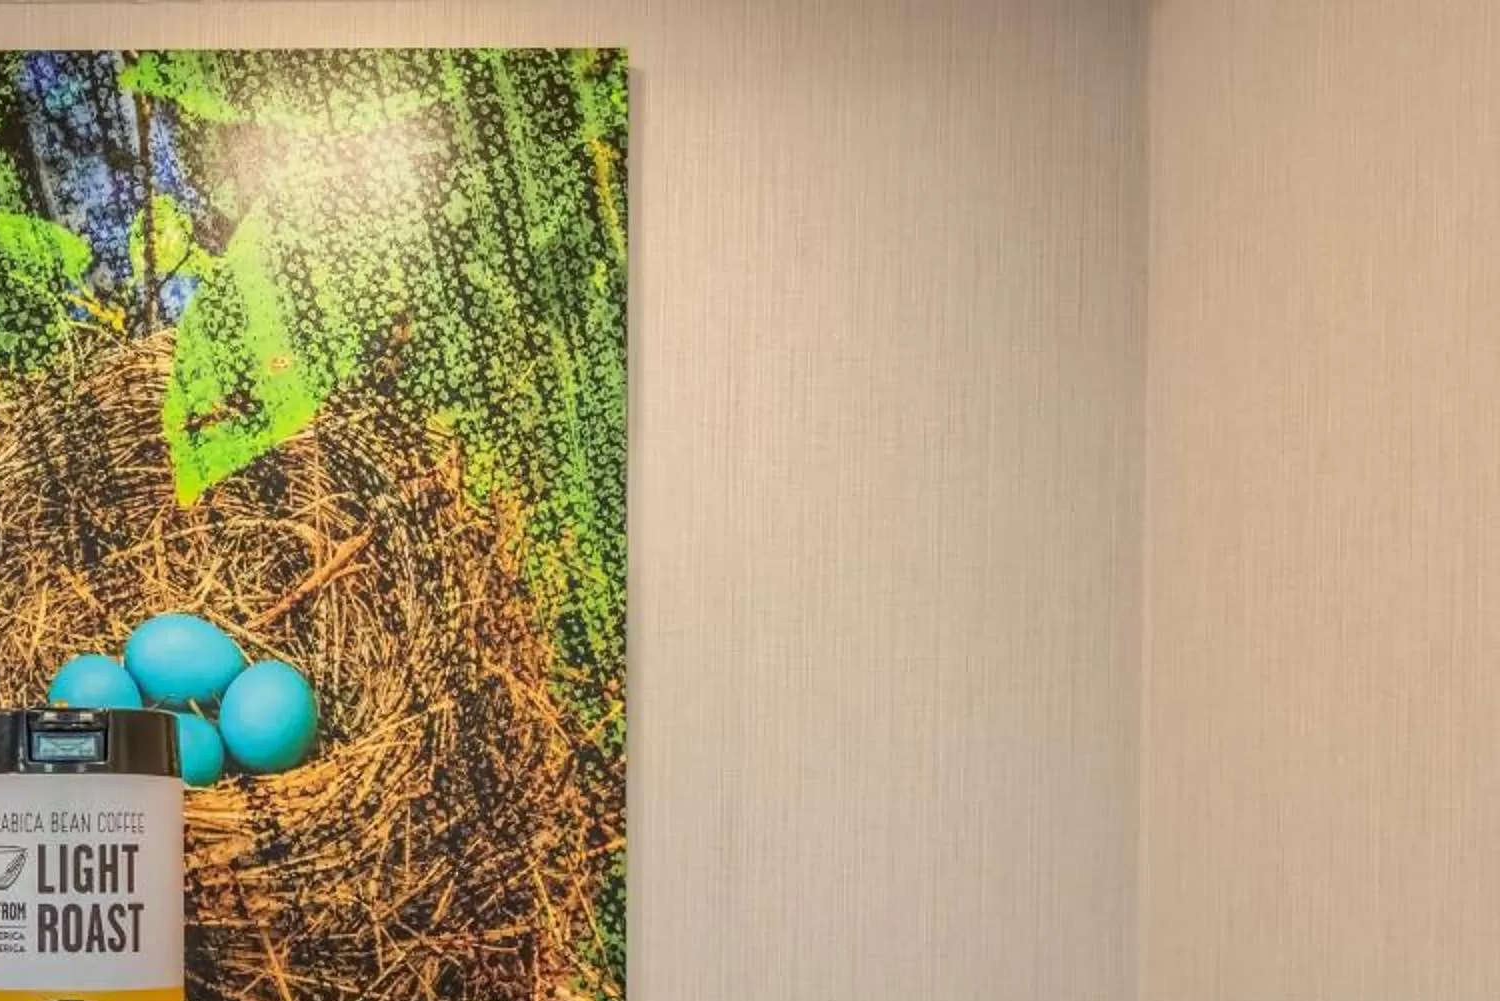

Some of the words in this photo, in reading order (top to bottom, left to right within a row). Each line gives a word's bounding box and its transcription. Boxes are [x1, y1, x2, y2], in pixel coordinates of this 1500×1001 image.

[51, 812, 92, 833] BEAN
[97, 812, 145, 834] COFFEE
[37, 844, 139, 893] LIGHT
[37, 903, 144, 953] ROAST
